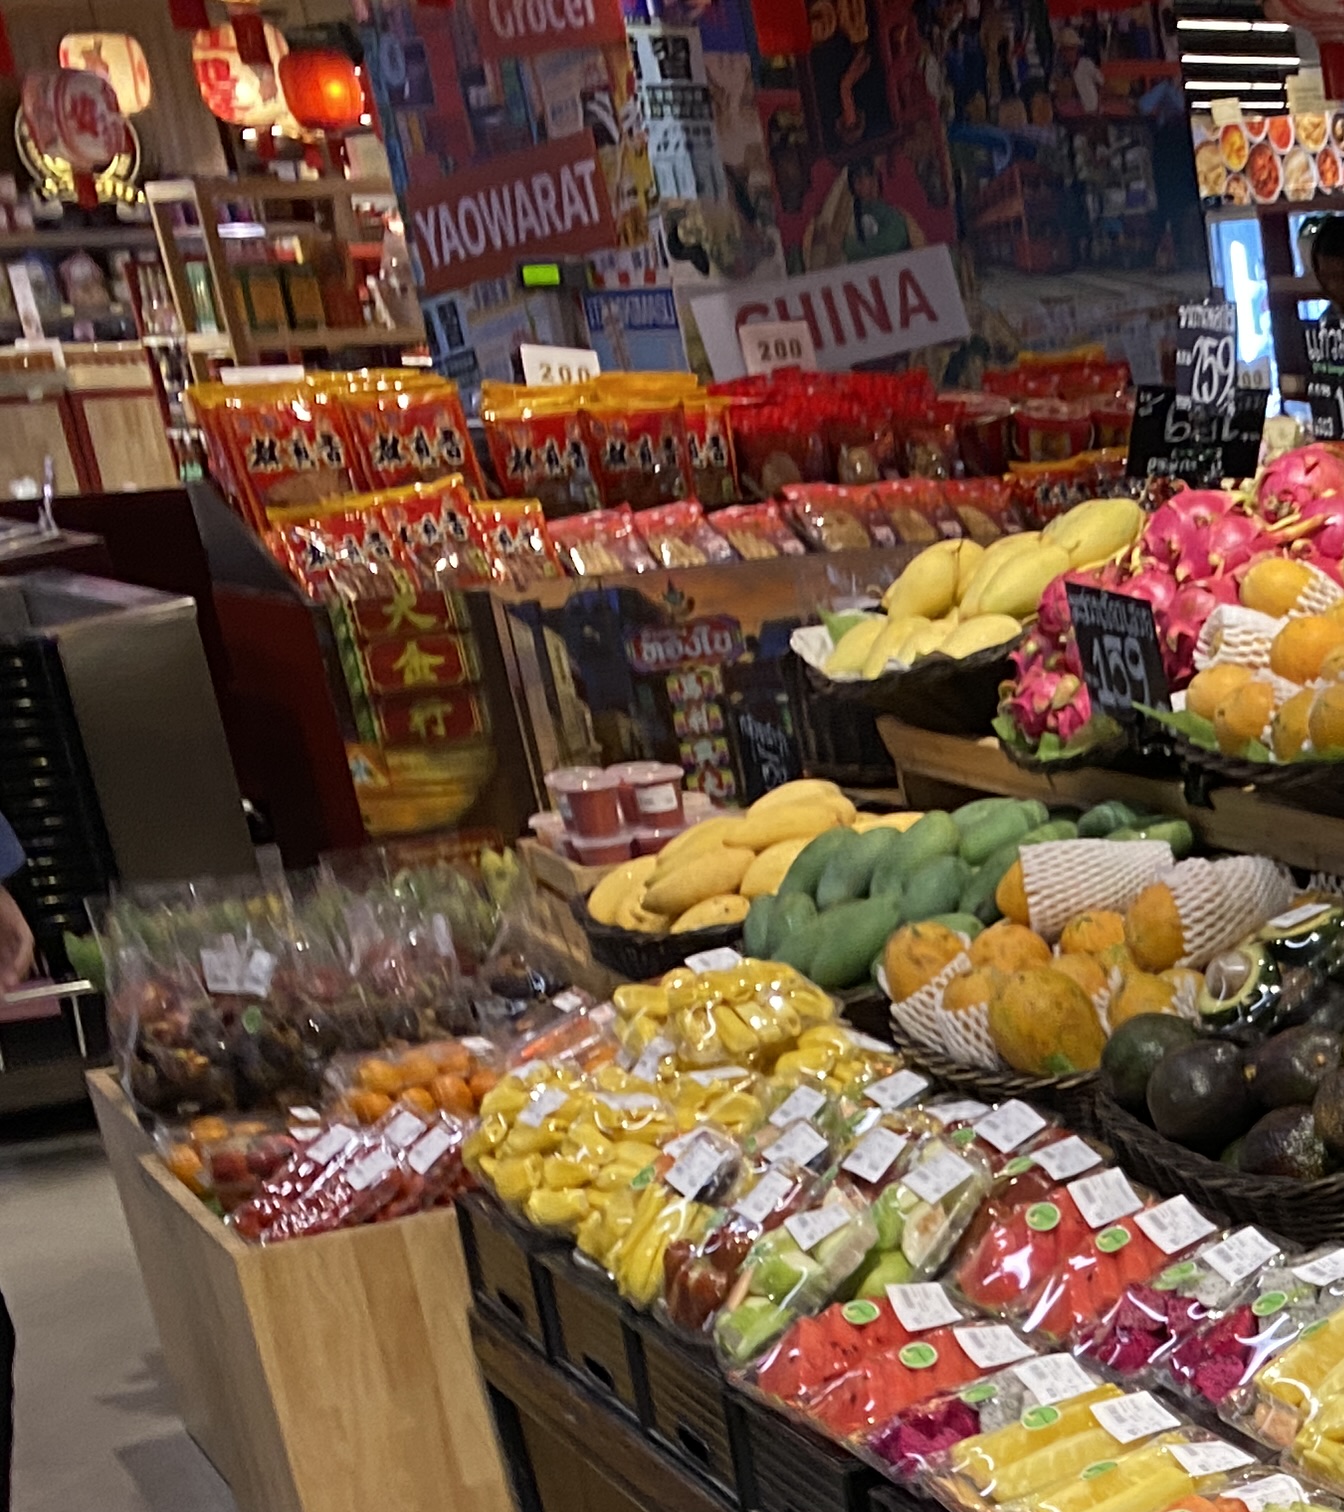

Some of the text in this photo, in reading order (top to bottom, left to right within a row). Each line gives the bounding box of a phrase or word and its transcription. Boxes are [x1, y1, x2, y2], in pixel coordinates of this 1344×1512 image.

[414, 159, 601, 271] YAOWARAT
[757, 339, 802, 361] 200
[1243, 371, 1264, 387] 00
